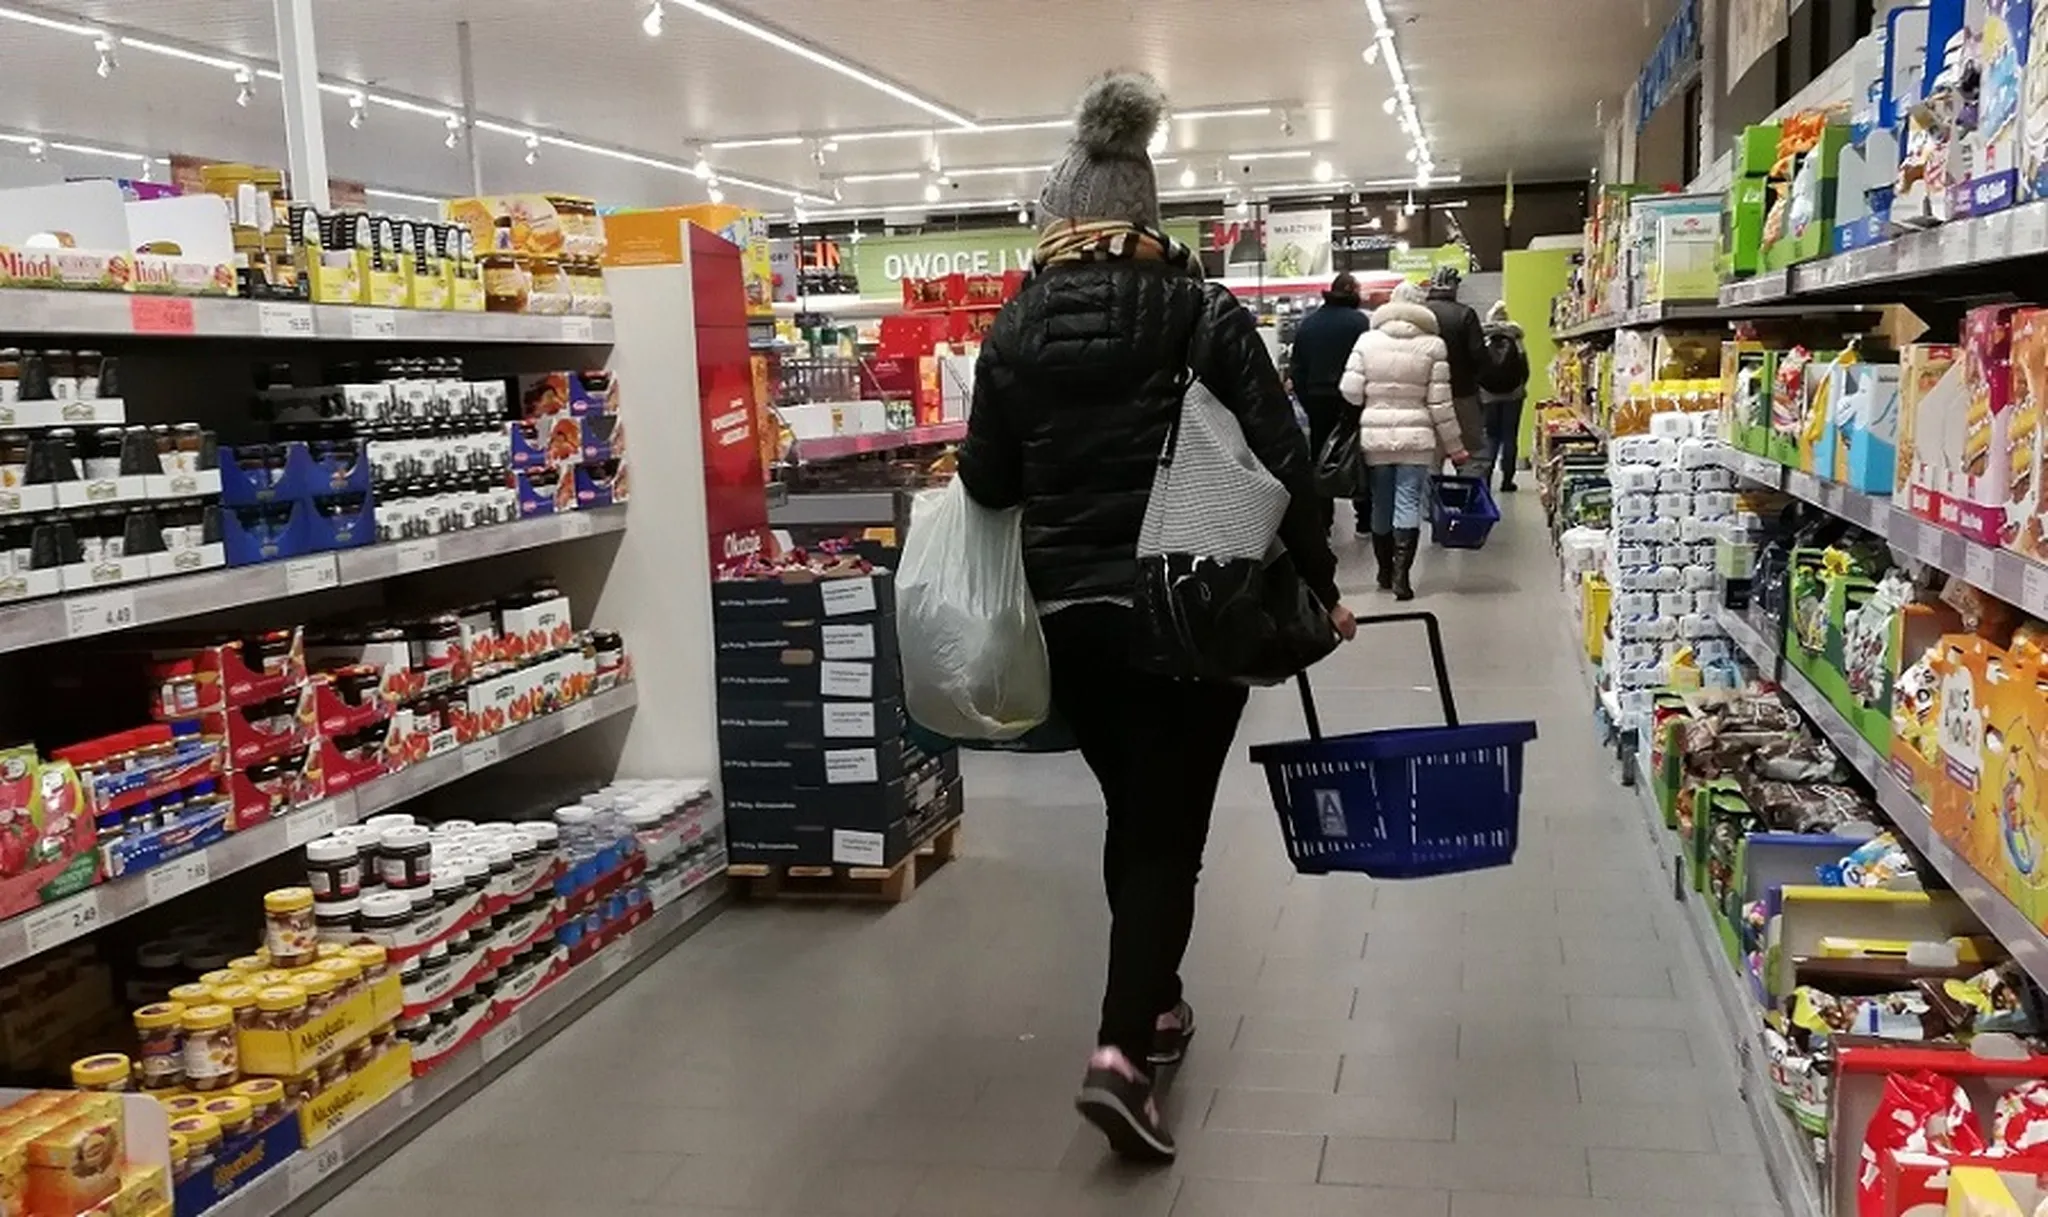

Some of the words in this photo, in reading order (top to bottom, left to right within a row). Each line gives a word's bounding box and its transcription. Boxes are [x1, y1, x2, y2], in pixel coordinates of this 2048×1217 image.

[884, 250, 989, 281] OWOCE
[105, 605, 131, 625] 4.49
[72, 905, 96, 928] 2.49
